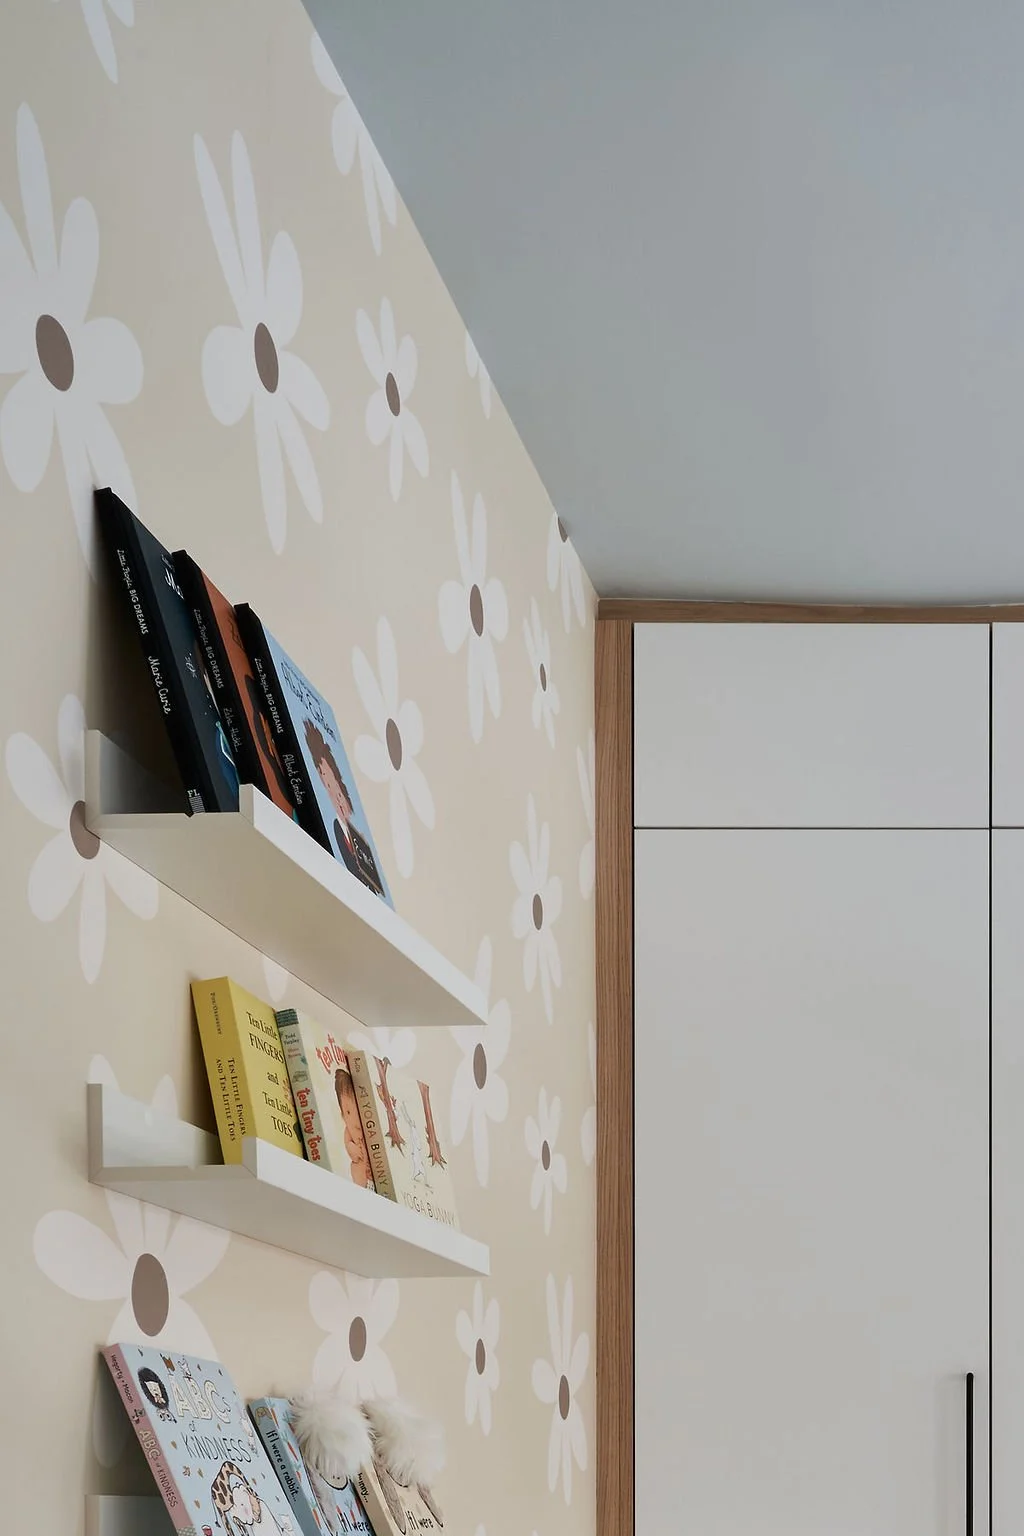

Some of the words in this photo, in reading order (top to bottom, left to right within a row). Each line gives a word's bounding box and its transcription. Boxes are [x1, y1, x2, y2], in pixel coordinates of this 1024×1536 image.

[129, 589, 139, 603] BIG
[133, 604, 149, 635] DREAMS
[205, 646, 215, 659] BIG
[210, 660, 224, 689] DREAMS
[148, 655, 163, 688] Marie
[158, 688, 171, 715] Curie
[266, 693, 275, 706] BIG
[270, 706, 284, 734] DREAMS
[282, 754, 299, 777] Albert
[246, 1010, 260, 1030] Ten
[258, 1019, 279, 1041] Little
[249, 1033, 284, 1064] FINGERS
[227, 1058, 236, 1074] TEN
[267, 1071, 280, 1086] and
[219, 1075, 227, 1092] TEN
[231, 1074, 241, 1102] LITTLE
[223, 1093, 232, 1121] LITTLE
[262, 1090, 277, 1109] Ten
[275, 1098, 293, 1118] Little
[297, 1087, 311, 1108] ten
[227, 1120, 236, 1142] TOES
[236, 1103, 246, 1136] FINGERS
[270, 1115, 293, 1138] TOES
[301, 1109, 317, 1135] tiny
[307, 1135, 321, 1162] toes
[362, 1102, 377, 1139] YOGA
[370, 1143, 389, 1186] BUNNY
[402, 1194, 427, 1217] YOGA
[425, 1202, 456, 1228] BUNNY
[168, 1374, 232, 1424] ABCs
[266, 1429, 279, 1439] If
[271, 1442, 283, 1464] were
[280, 1463, 286, 1471] a
[352, 1521, 370, 1533] were
[405, 1511, 416, 1531] If
[418, 1518, 434, 1529] were
